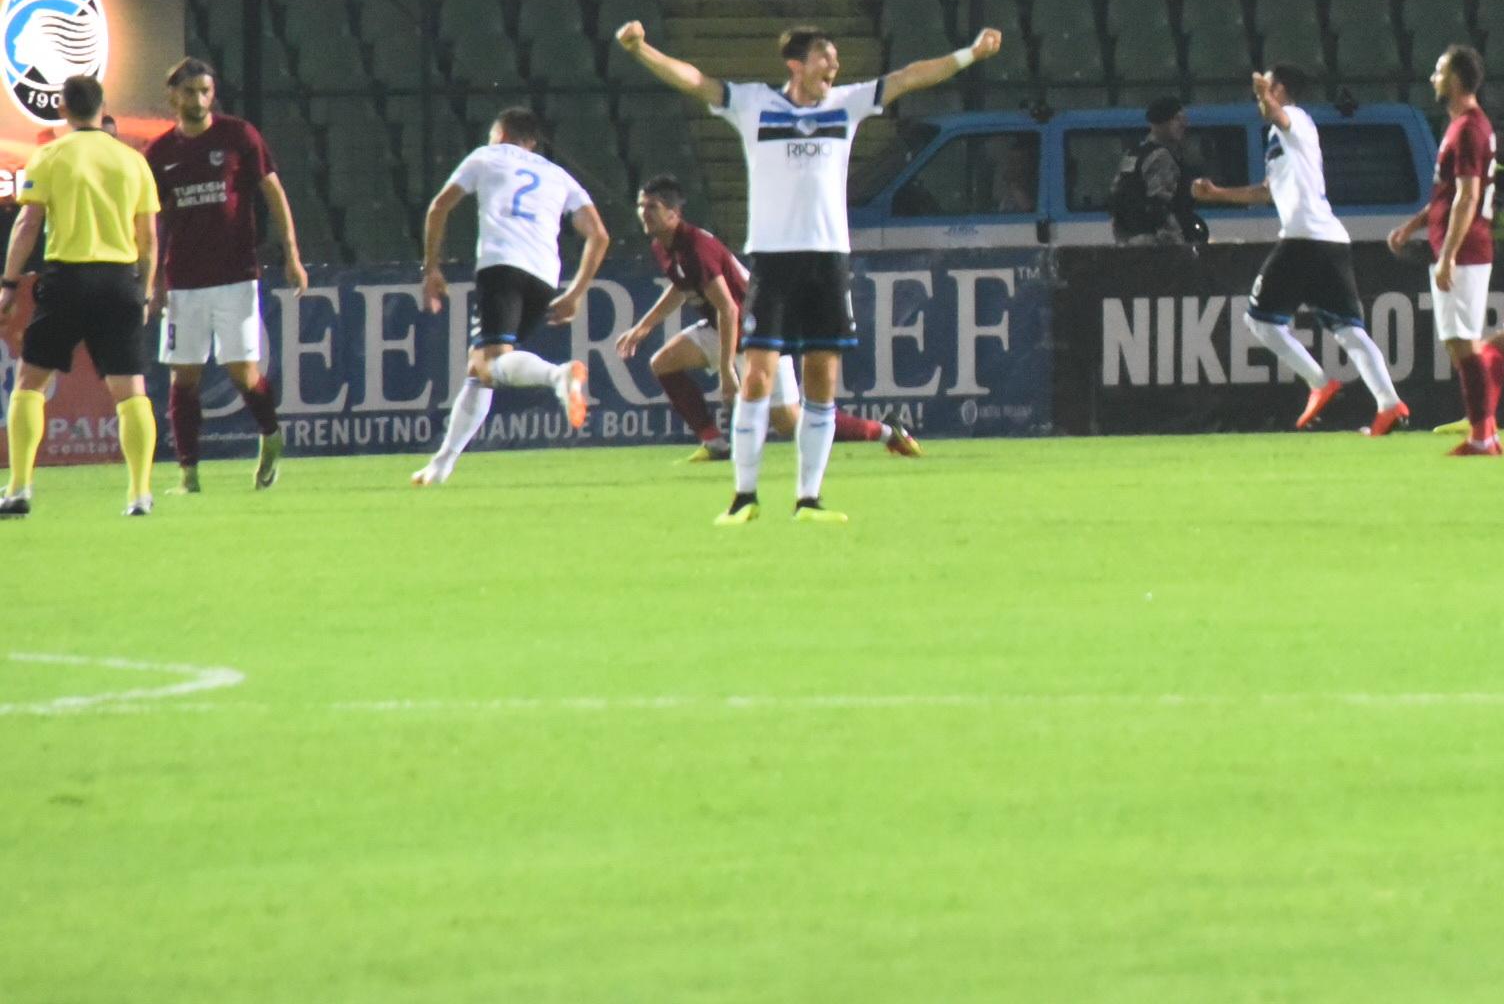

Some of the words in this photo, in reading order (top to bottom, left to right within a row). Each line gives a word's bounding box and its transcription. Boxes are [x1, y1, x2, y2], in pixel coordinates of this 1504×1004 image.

[27, 90, 61, 109] 190
[511, 168, 541, 222] 2
[277, 415, 432, 446] TRENUTNO
[603, 409, 654, 439] BOL
